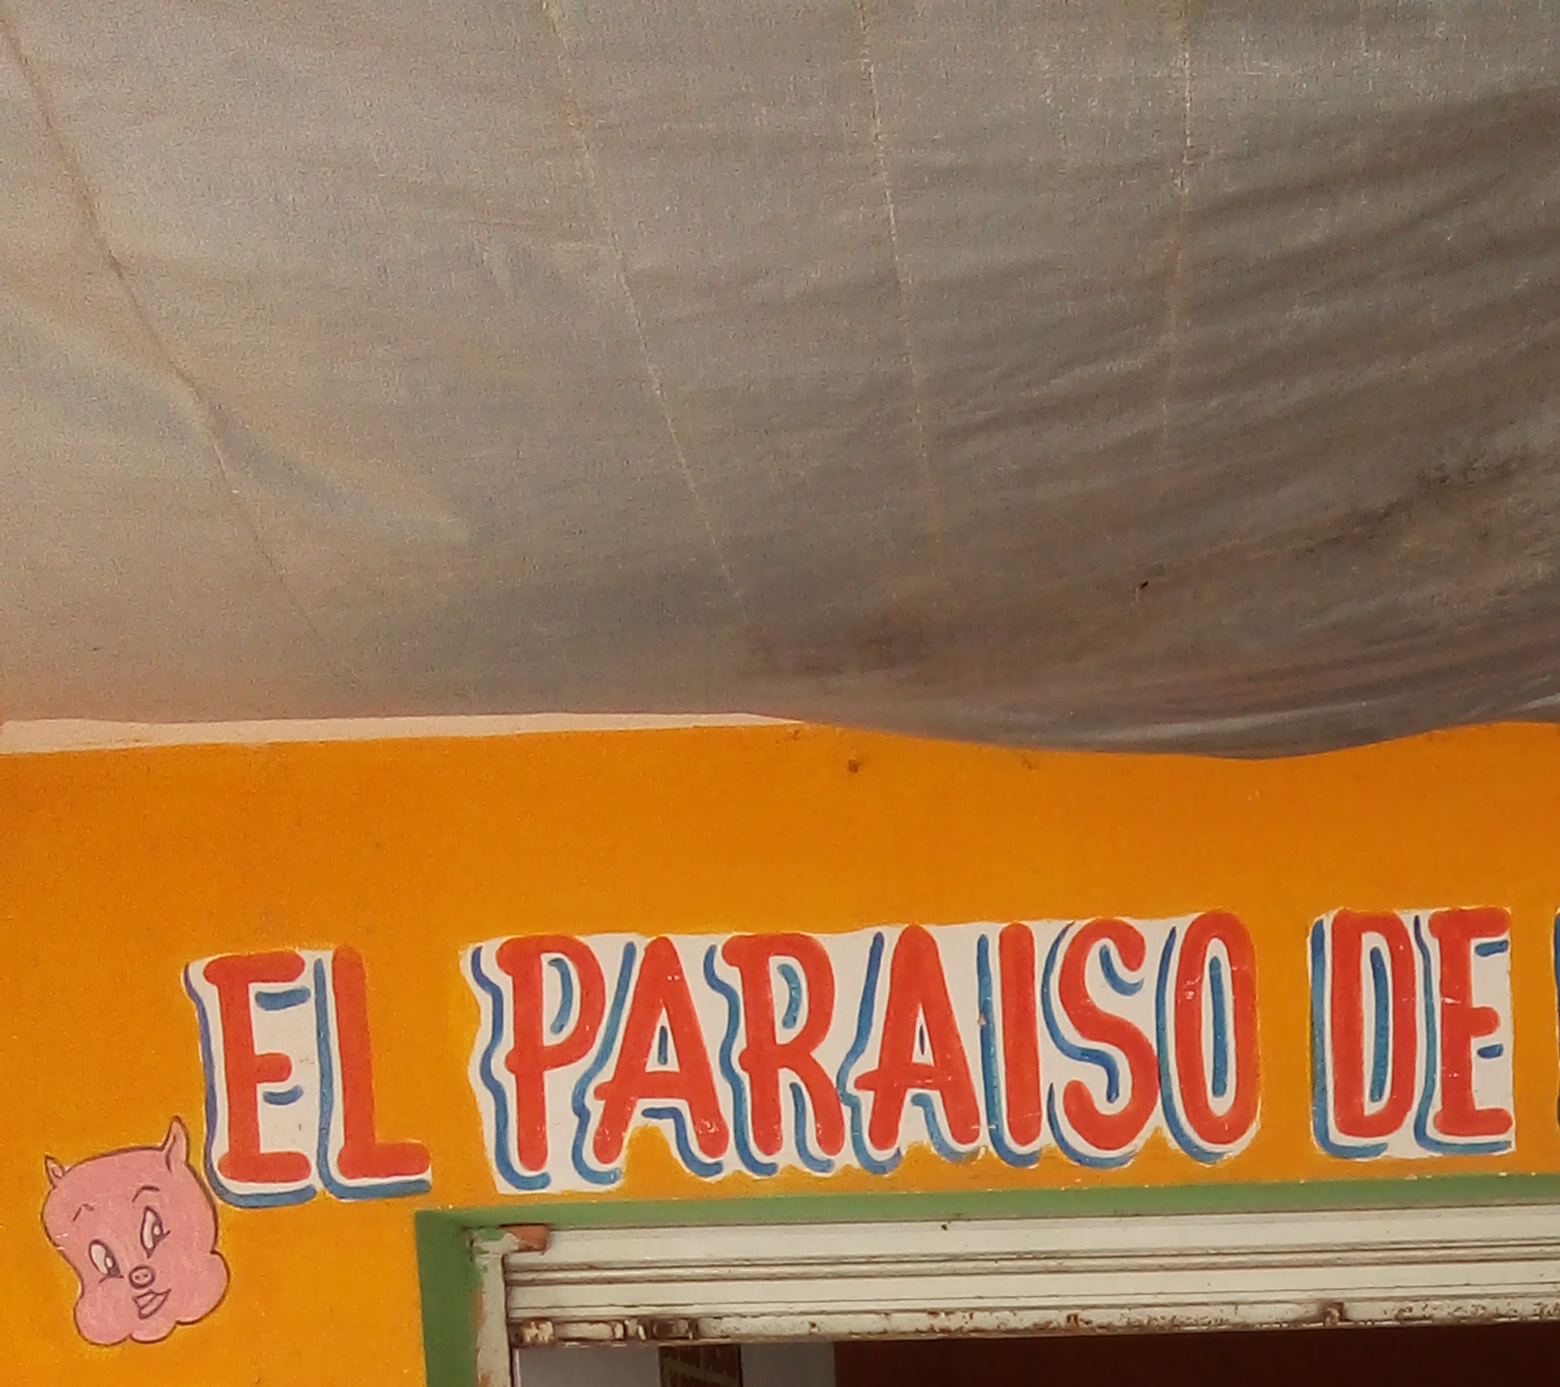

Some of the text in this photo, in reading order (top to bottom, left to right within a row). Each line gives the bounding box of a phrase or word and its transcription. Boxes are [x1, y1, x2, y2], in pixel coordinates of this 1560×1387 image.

[186, 944, 432, 1208] EL
[472, 911, 1259, 1190] PARAISO
[1311, 905, 1511, 1157] DE
